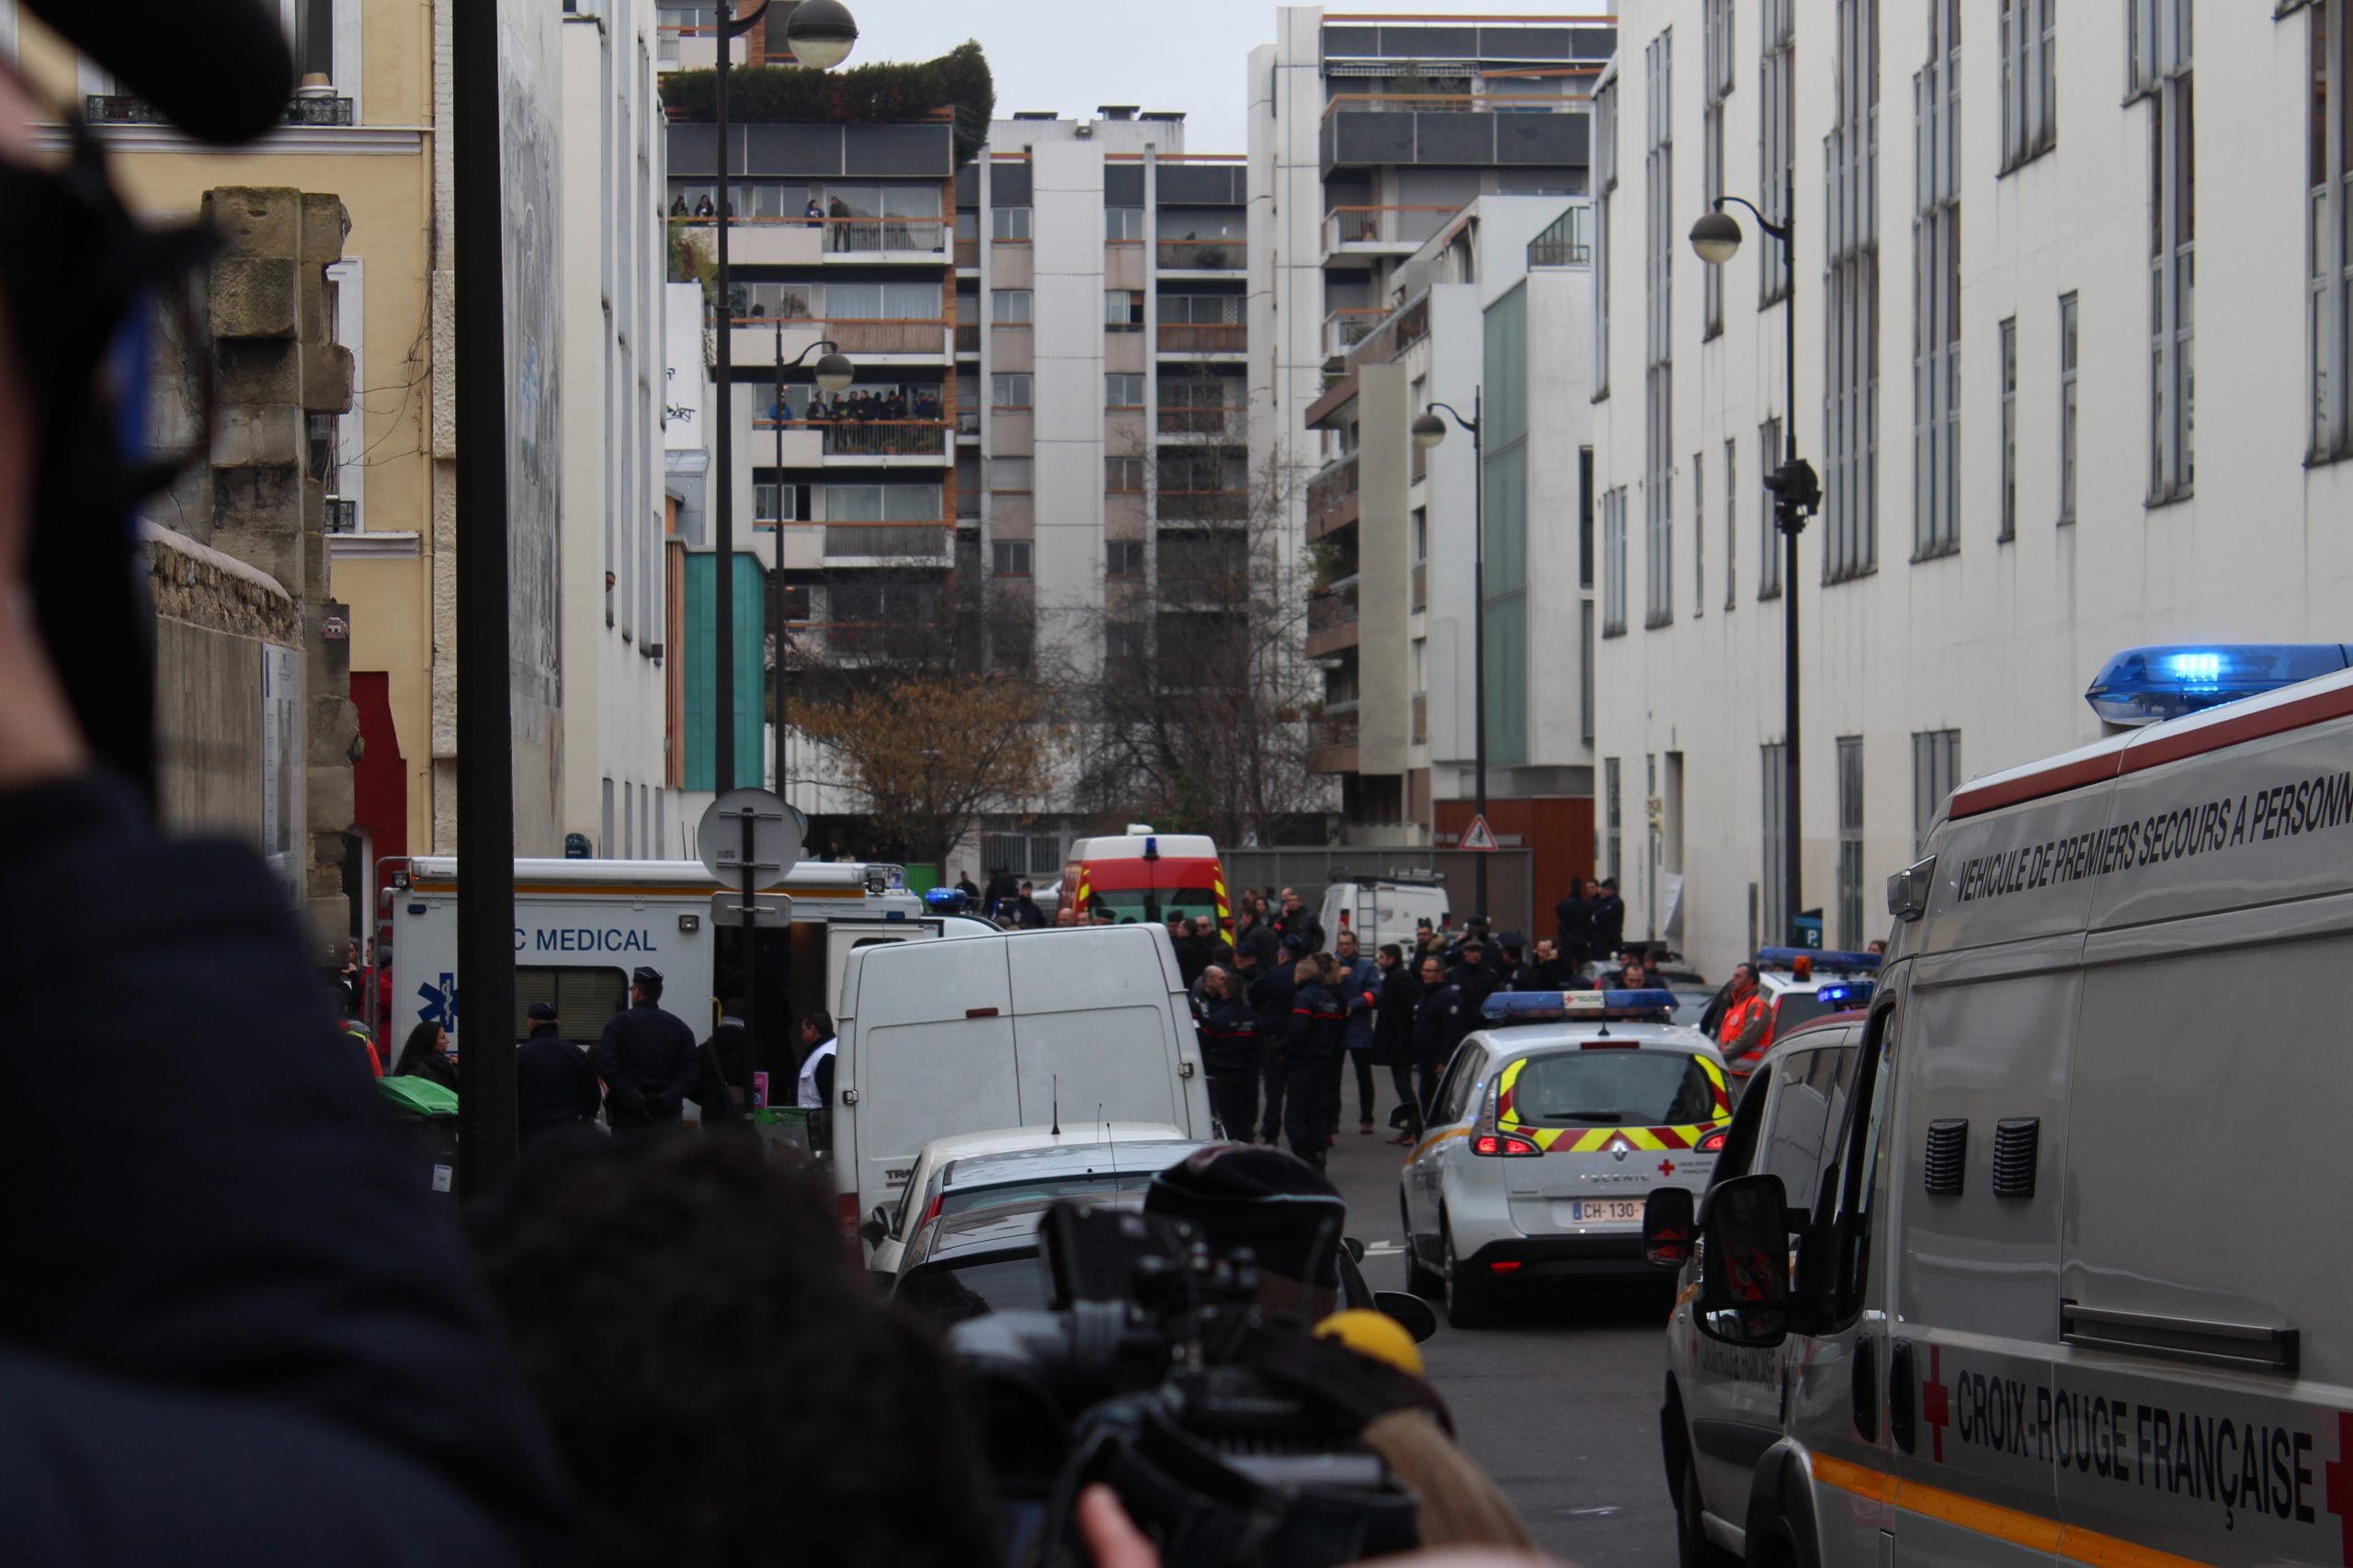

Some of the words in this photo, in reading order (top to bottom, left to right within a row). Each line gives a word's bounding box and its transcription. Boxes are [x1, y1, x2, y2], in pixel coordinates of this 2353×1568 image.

[1958, 847, 2029, 903] VEHICULE
[2027, 844, 2052, 890] DE
[2052, 825, 2140, 882] PREMIERS
[2139, 799, 2232, 867] SECOURS
[2230, 794, 2248, 846] A
[536, 928, 657, 951] MEDICAL
[1584, 1203, 1647, 1219] CH-130-
[1957, 1369, 2128, 1481] CROIX-ROUGE
[2137, 1404, 2315, 1531] FRANÇAISE
